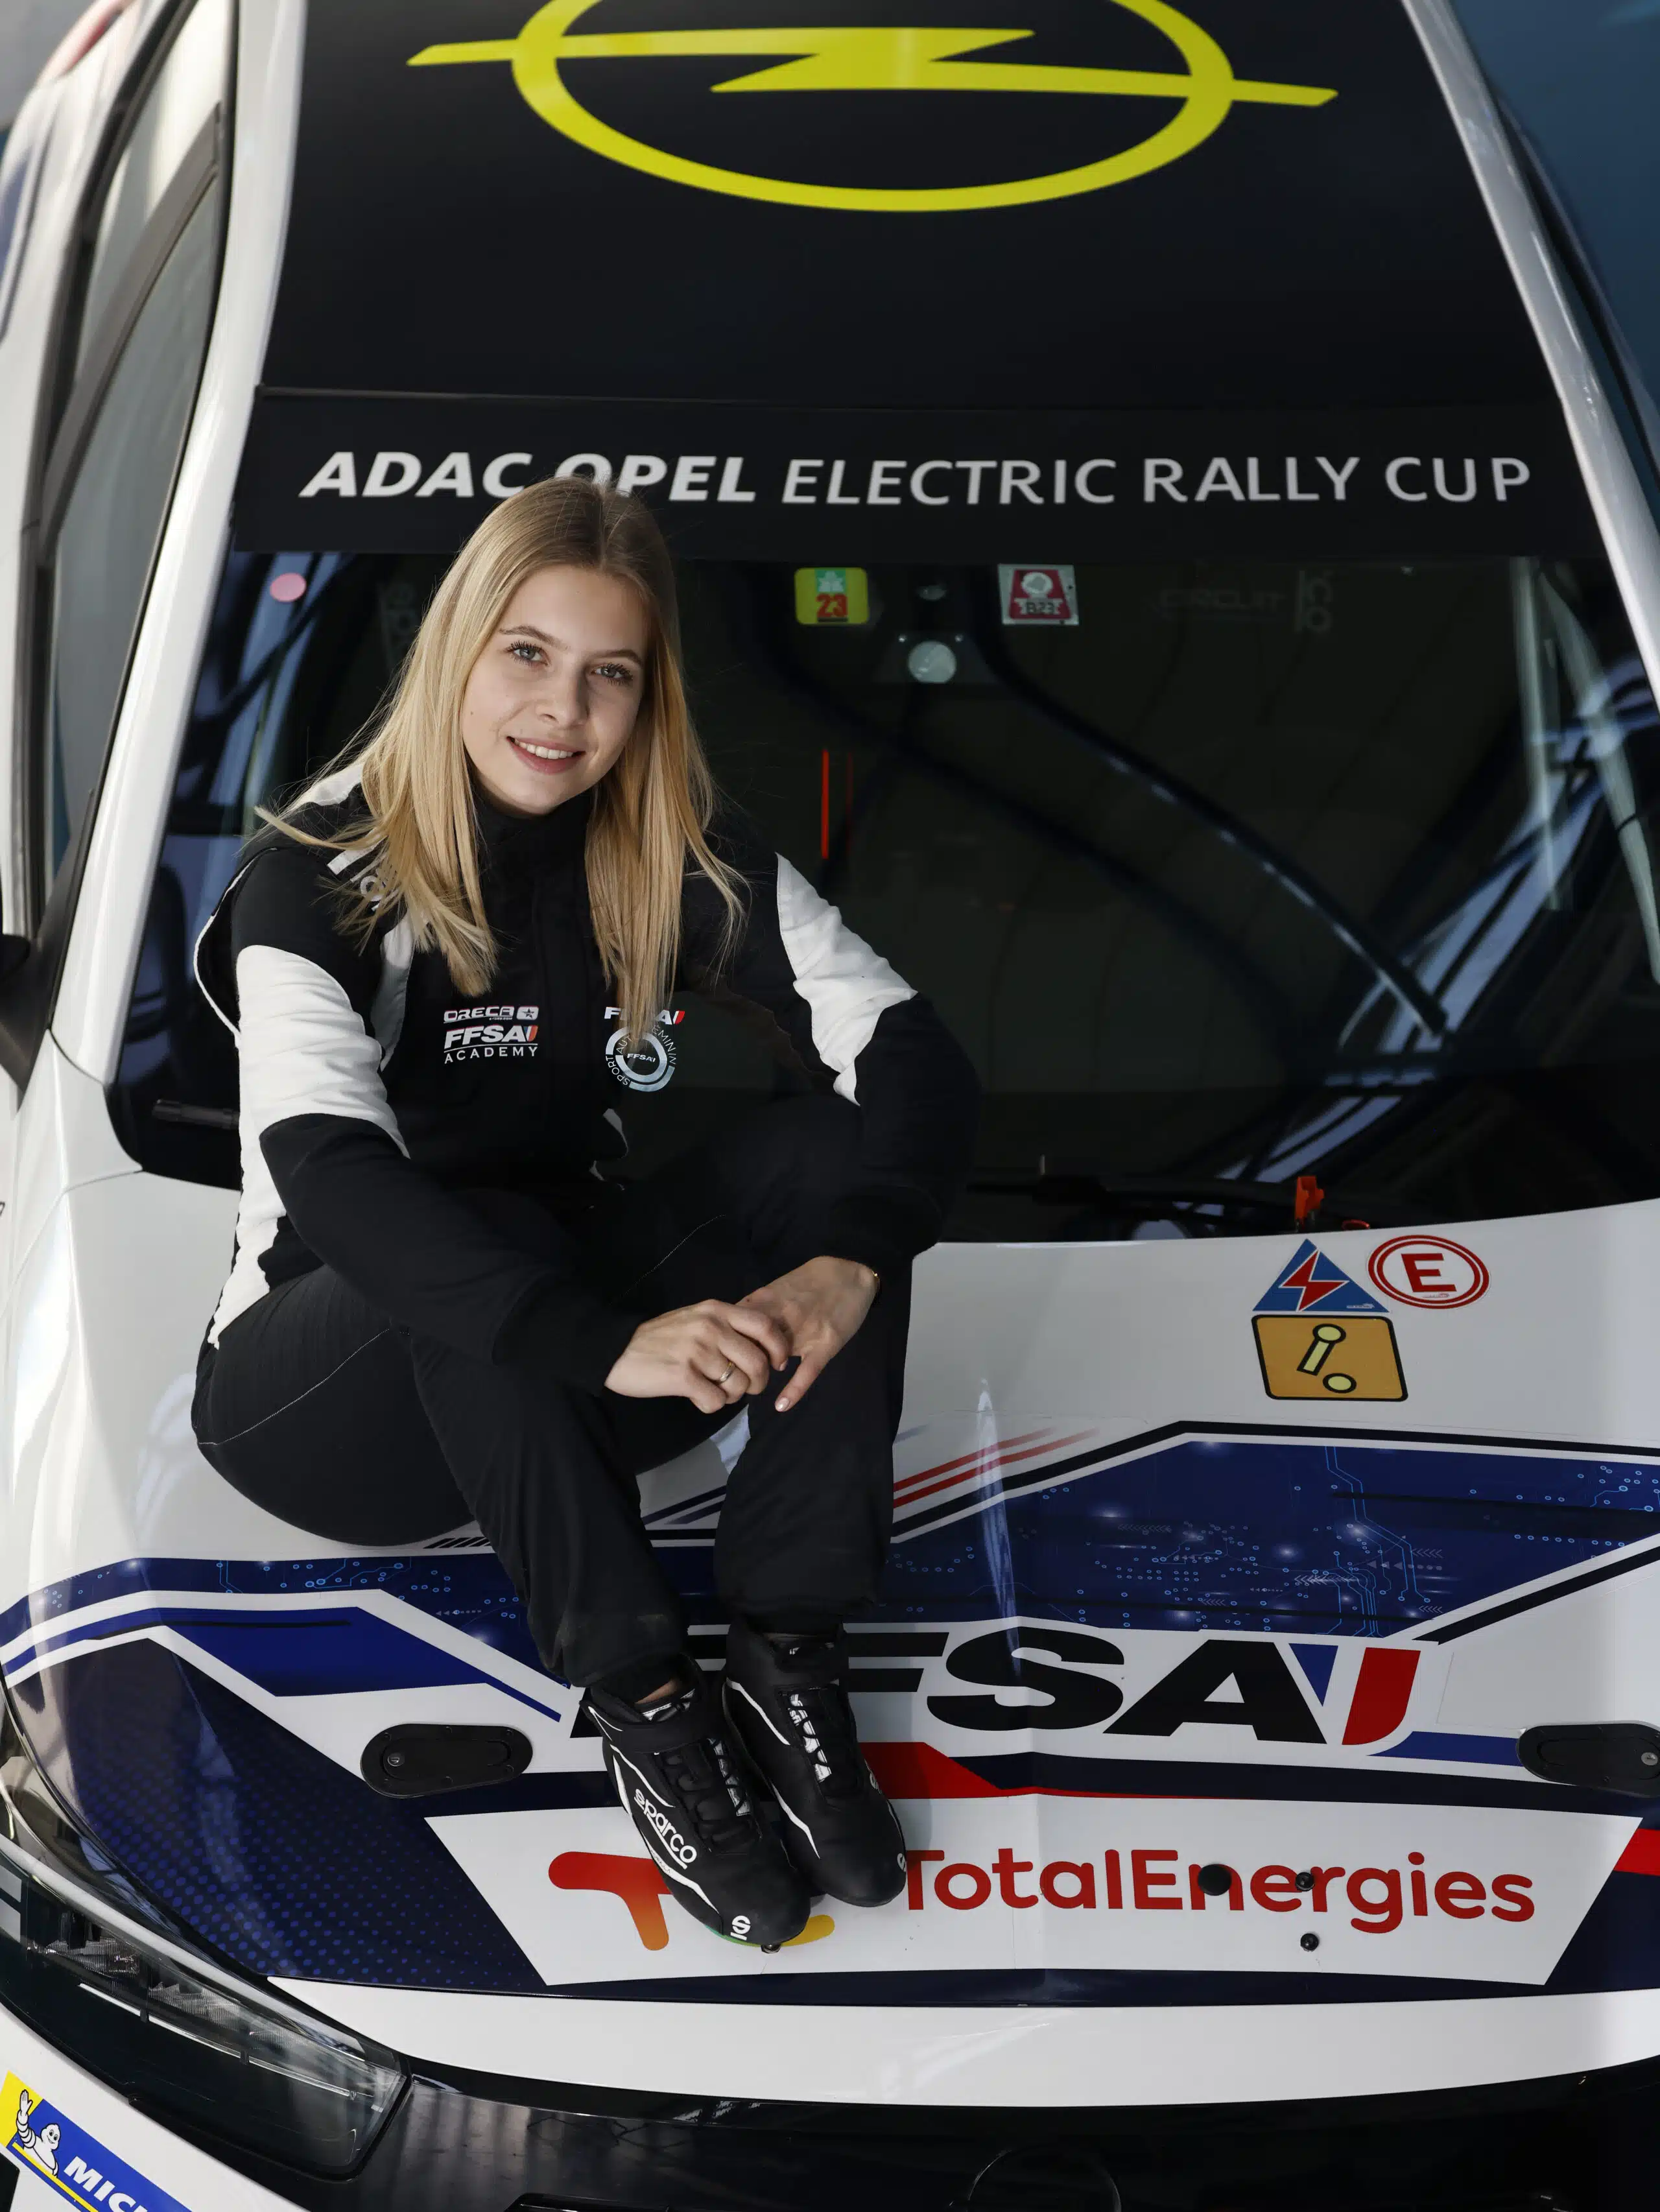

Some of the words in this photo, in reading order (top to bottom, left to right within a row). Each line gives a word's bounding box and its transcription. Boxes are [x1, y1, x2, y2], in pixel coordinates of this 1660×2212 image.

[298, 451, 532, 497] ADAC
[554, 453, 757, 502] OPEL
[781, 458, 1117, 505] ELECTRIC
[1143, 457, 1360, 502] RALLY
[1384, 457, 1531, 502] CUP
[816, 593, 848, 617] 23
[444, 1006, 515, 1023] ORECA
[604, 1006, 672, 1025] FA
[444, 1046, 538, 1064] ACADEMY
[651, 1025, 677, 1064] ÉMININ
[605, 1055, 630, 1086] SPORT
[1400, 1253, 1457, 1293] E
[634, 1789, 697, 1864] sparco
[905, 1848, 1535, 1934] TotalEnergies
[64, 2156, 148, 2212] MIC
